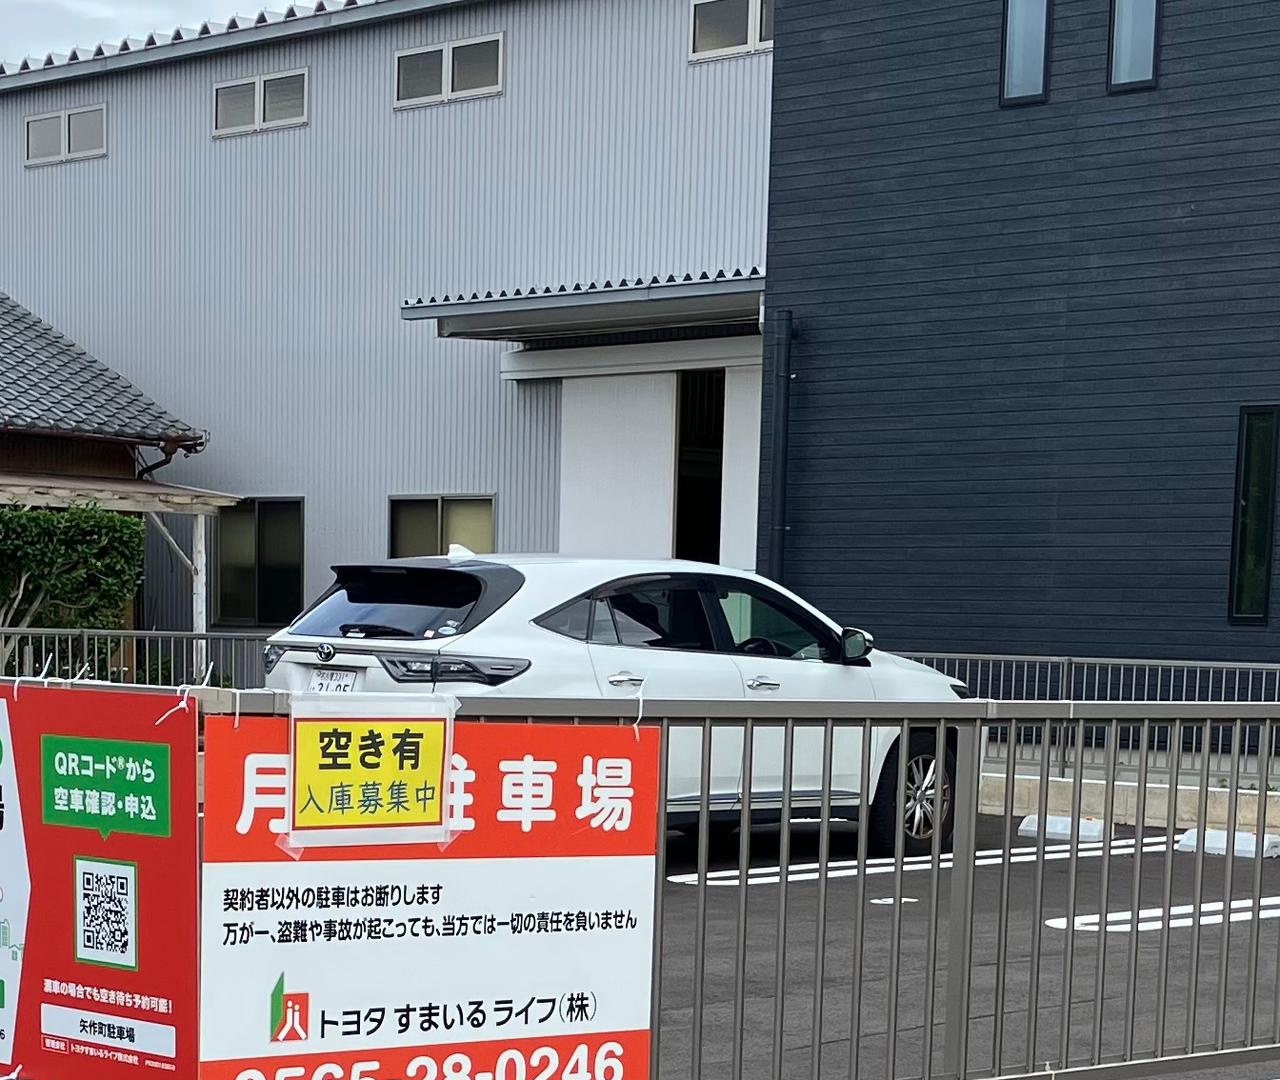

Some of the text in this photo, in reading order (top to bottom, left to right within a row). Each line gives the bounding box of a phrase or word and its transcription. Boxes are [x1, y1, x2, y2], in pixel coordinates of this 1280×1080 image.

[318, 728, 424, 771] 空き有
[54, 786, 157, 821] 空車確認・申込
[299, 780, 437, 816] 入庫募集中
[223, 882, 444, 912] 契約者以外の駐車はお断りします
[222, 909, 638, 947] 万が一、盗難や事故が起こっても、当方では一切の責任を負いません
